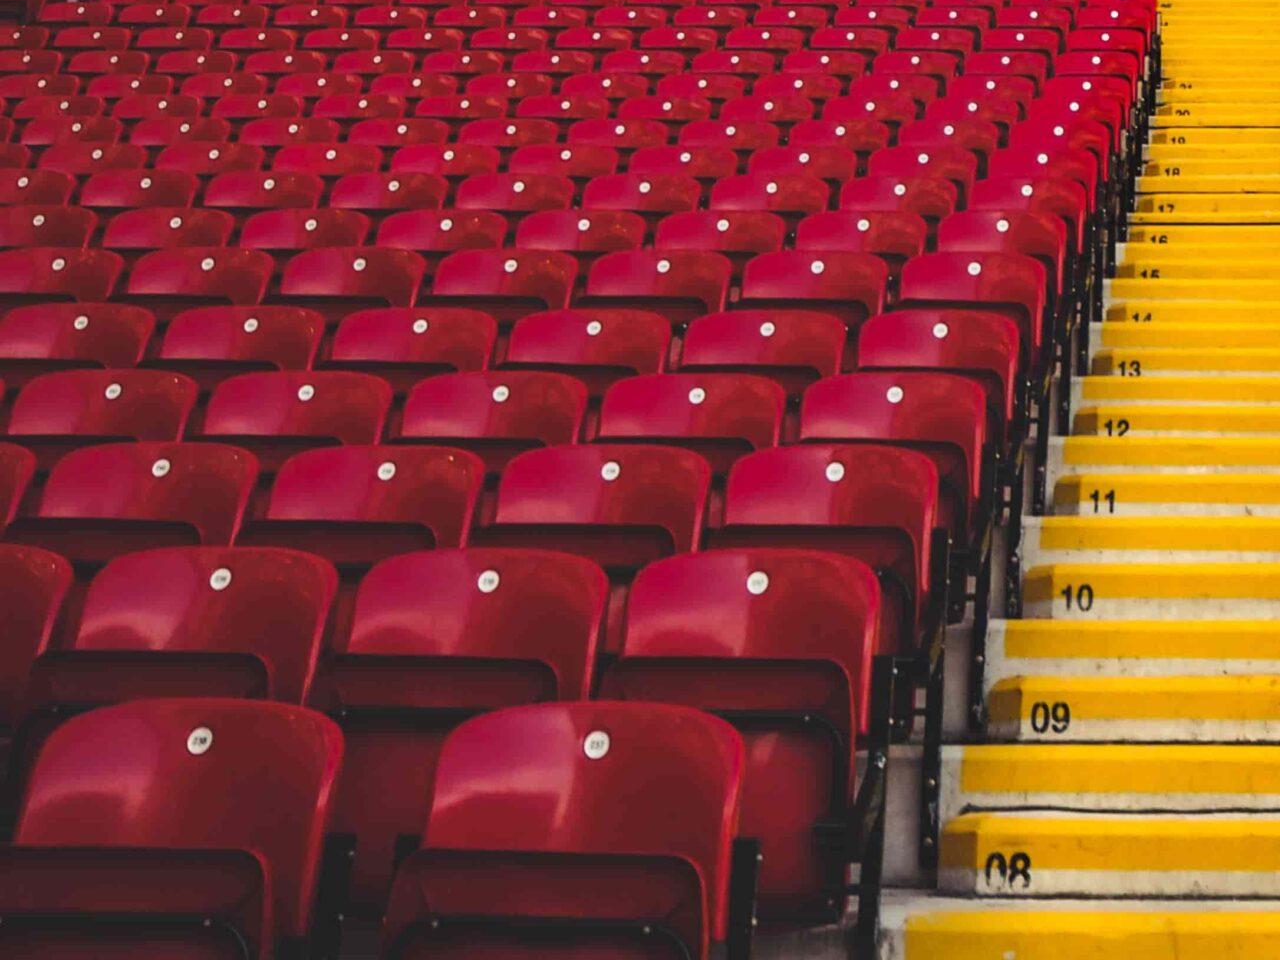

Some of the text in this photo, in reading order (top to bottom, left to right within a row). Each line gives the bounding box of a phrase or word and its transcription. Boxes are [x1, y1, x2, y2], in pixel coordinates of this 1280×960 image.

[1118, 360, 1141, 376] 13
[1104, 419, 1130, 437] 12
[1089, 489, 1115, 514] 11
[1060, 583, 1094, 612] 10
[1030, 701, 1071, 734] 09
[985, 852, 1031, 891] 08
